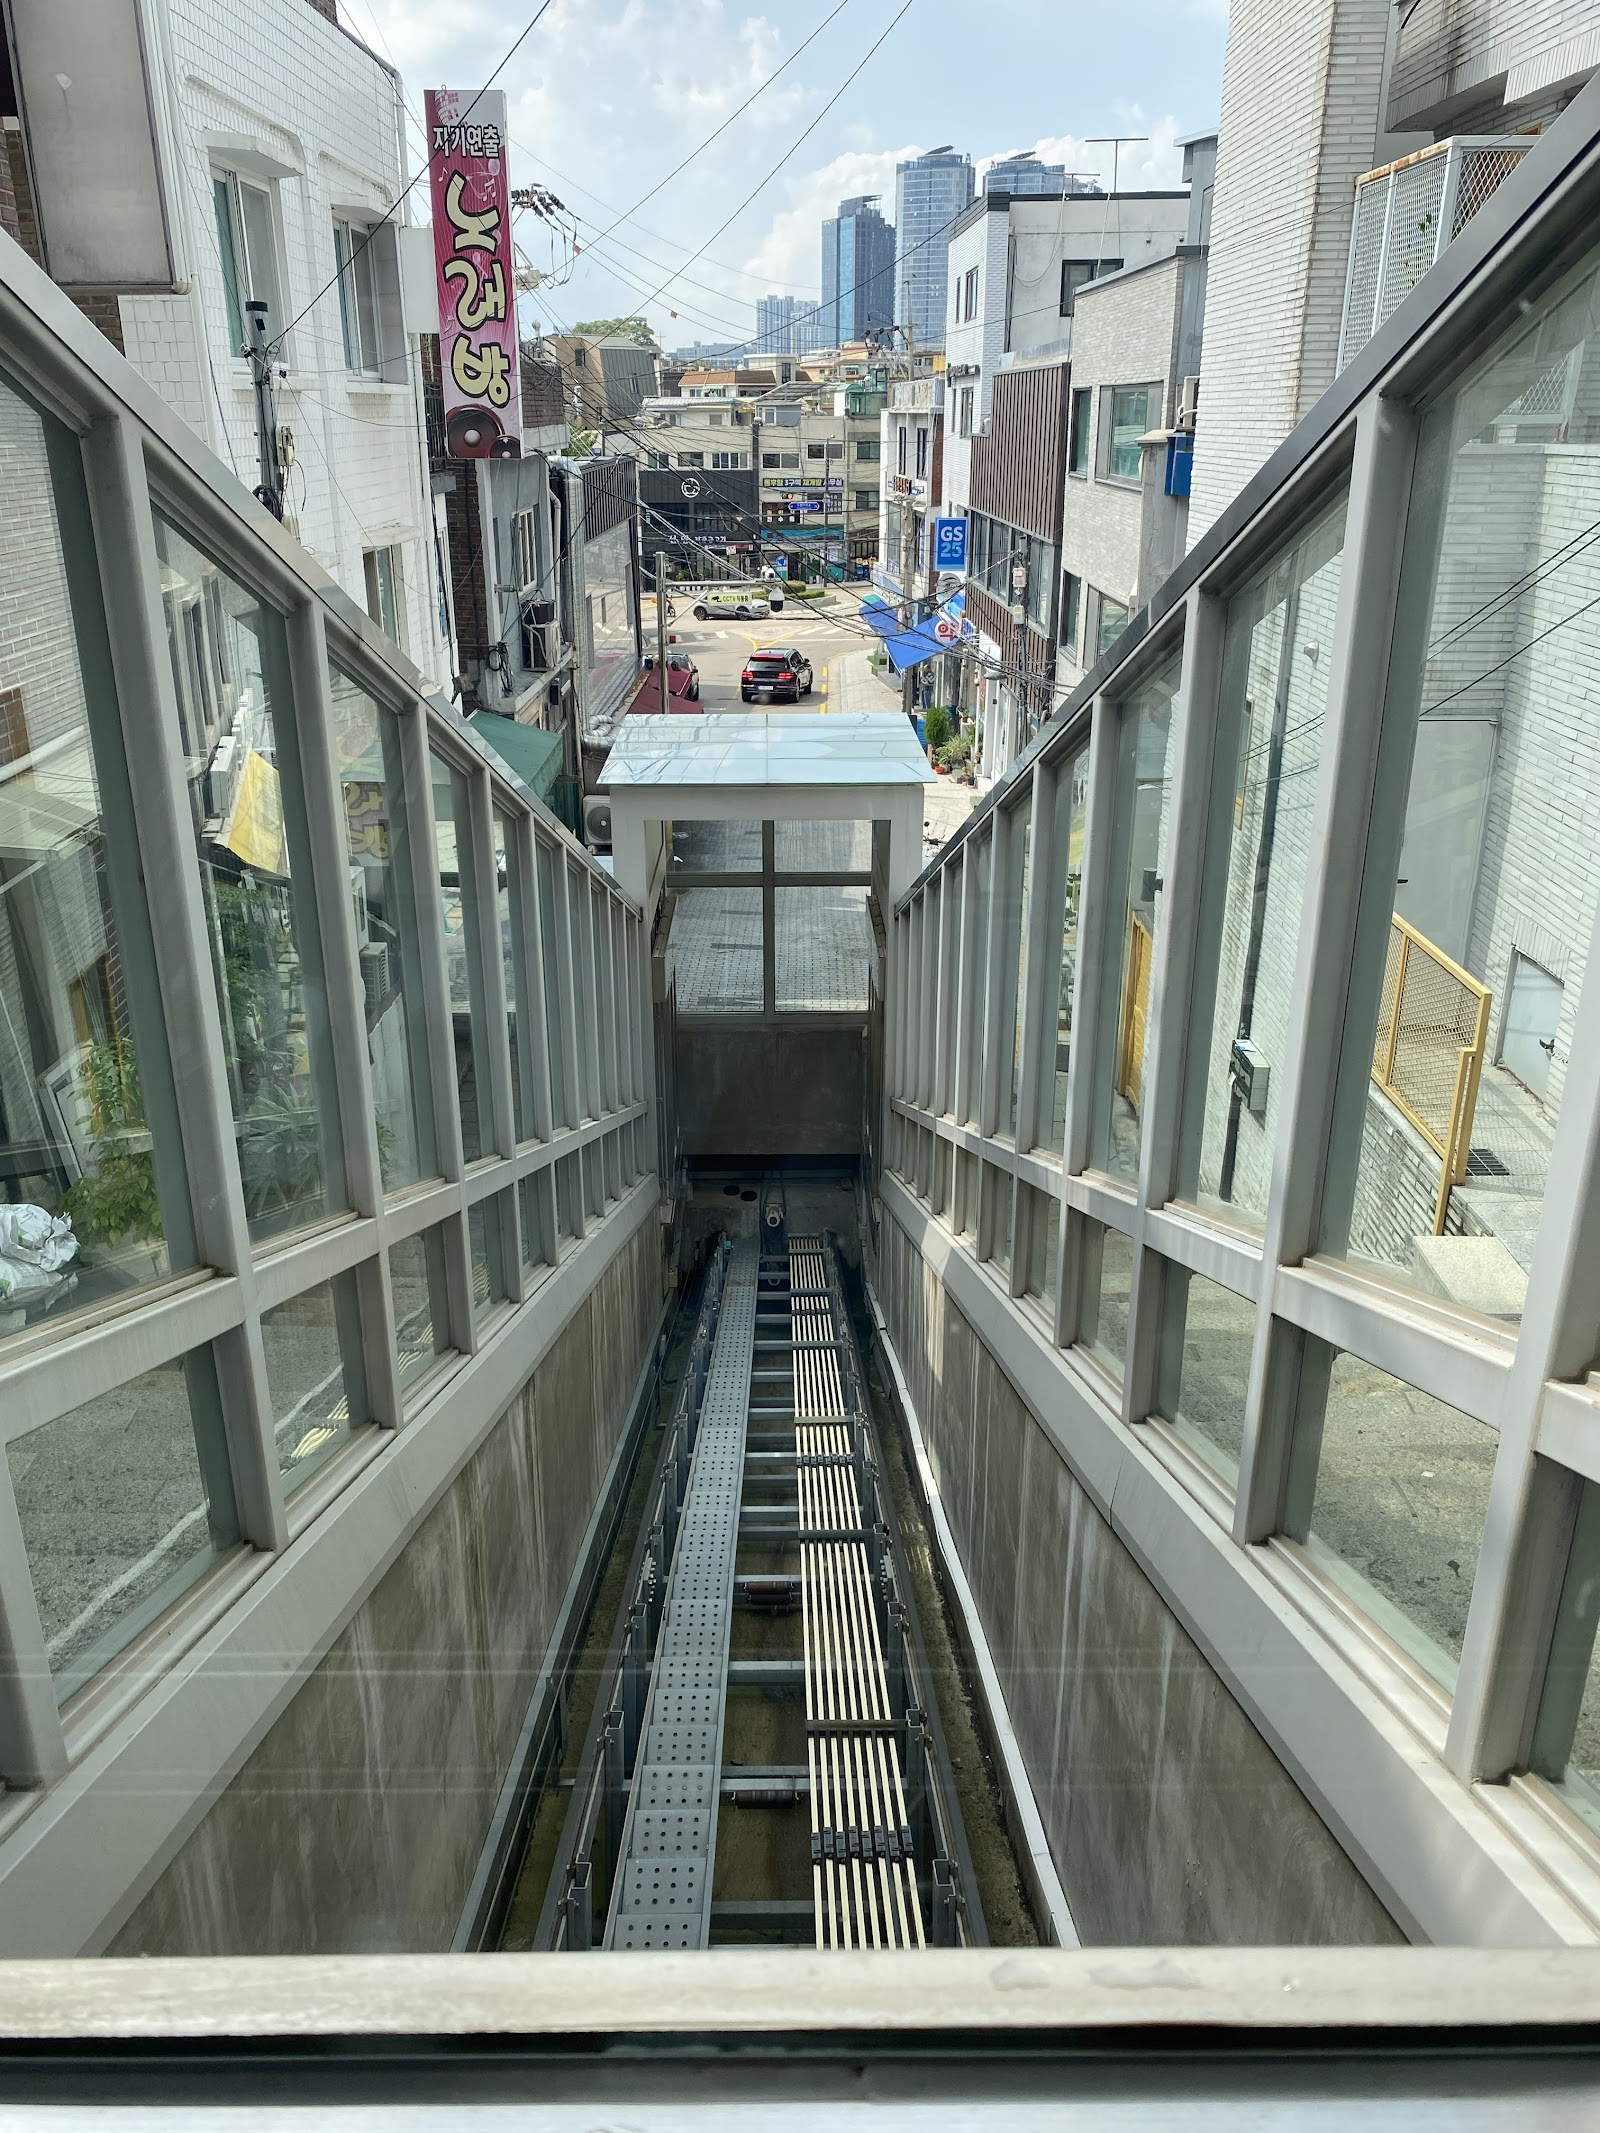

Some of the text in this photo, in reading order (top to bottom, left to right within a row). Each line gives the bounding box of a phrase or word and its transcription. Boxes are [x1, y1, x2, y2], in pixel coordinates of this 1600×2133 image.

[433, 124, 500, 157] 자기연출
[444, 170, 511, 408] 노래방
[784, 478, 802, 487] 3구역
[802, 478, 822, 487] 재개발
[940, 526, 964, 541] GS
[940, 542, 963, 557] 25
